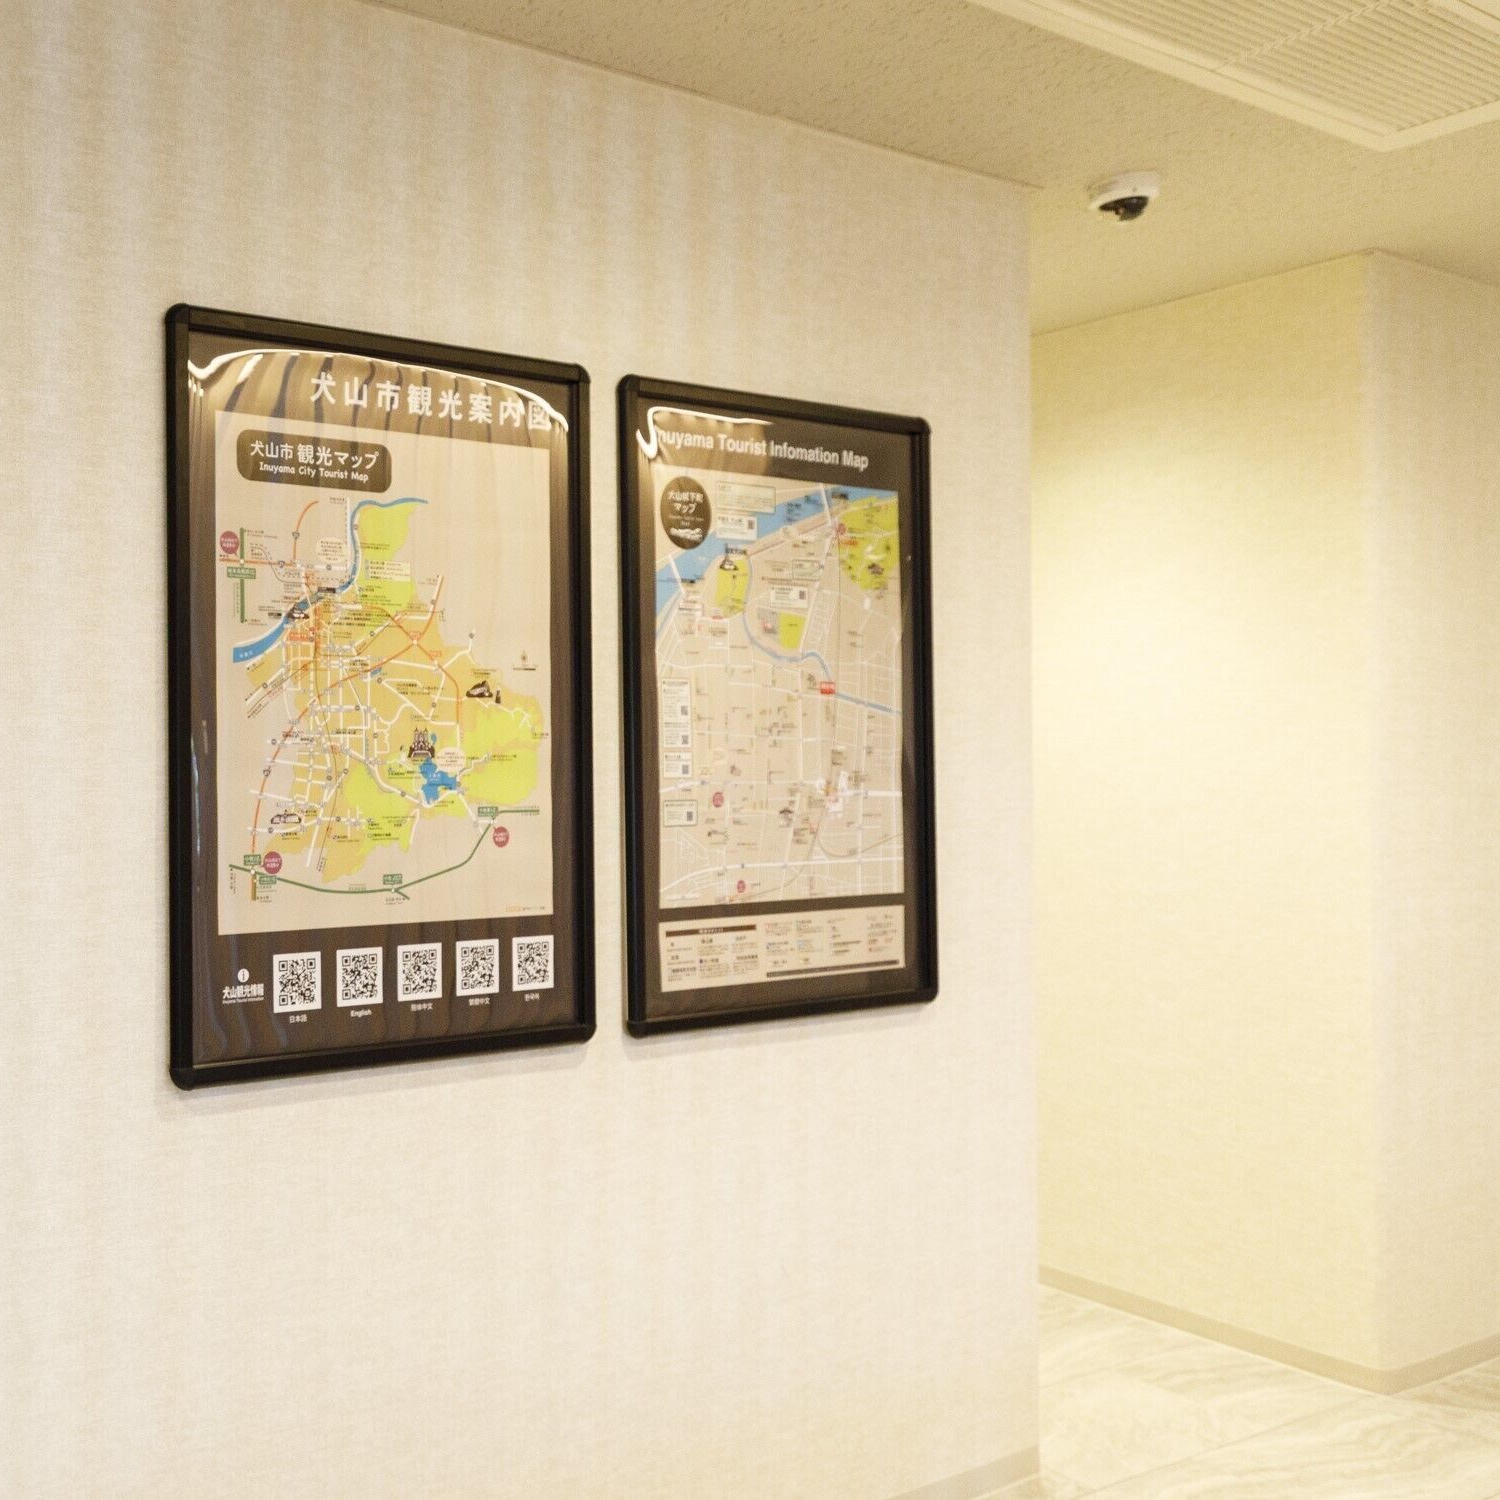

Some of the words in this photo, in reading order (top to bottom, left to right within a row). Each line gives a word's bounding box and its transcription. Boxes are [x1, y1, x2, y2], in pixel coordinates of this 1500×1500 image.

[310, 372, 553, 432] 犬山市観光案内図
[250, 441, 295, 460] 犬山市
[297, 445, 380, 471] 観光マップ
[655, 426, 715, 450] nuyama
[717, 433, 768, 456] Tourist
[769, 441, 840, 466] Infomation
[841, 450, 870, 474] Map
[258, 461, 296, 477] Inuyama
[297, 465, 316, 480] City
[318, 467, 350, 482] Tourist
[350, 470, 370, 484] Map
[222, 983, 265, 1000] 犬山観光情報
[289, 1014, 308, 1024] 日本語
[350, 1008, 373, 1018] English
